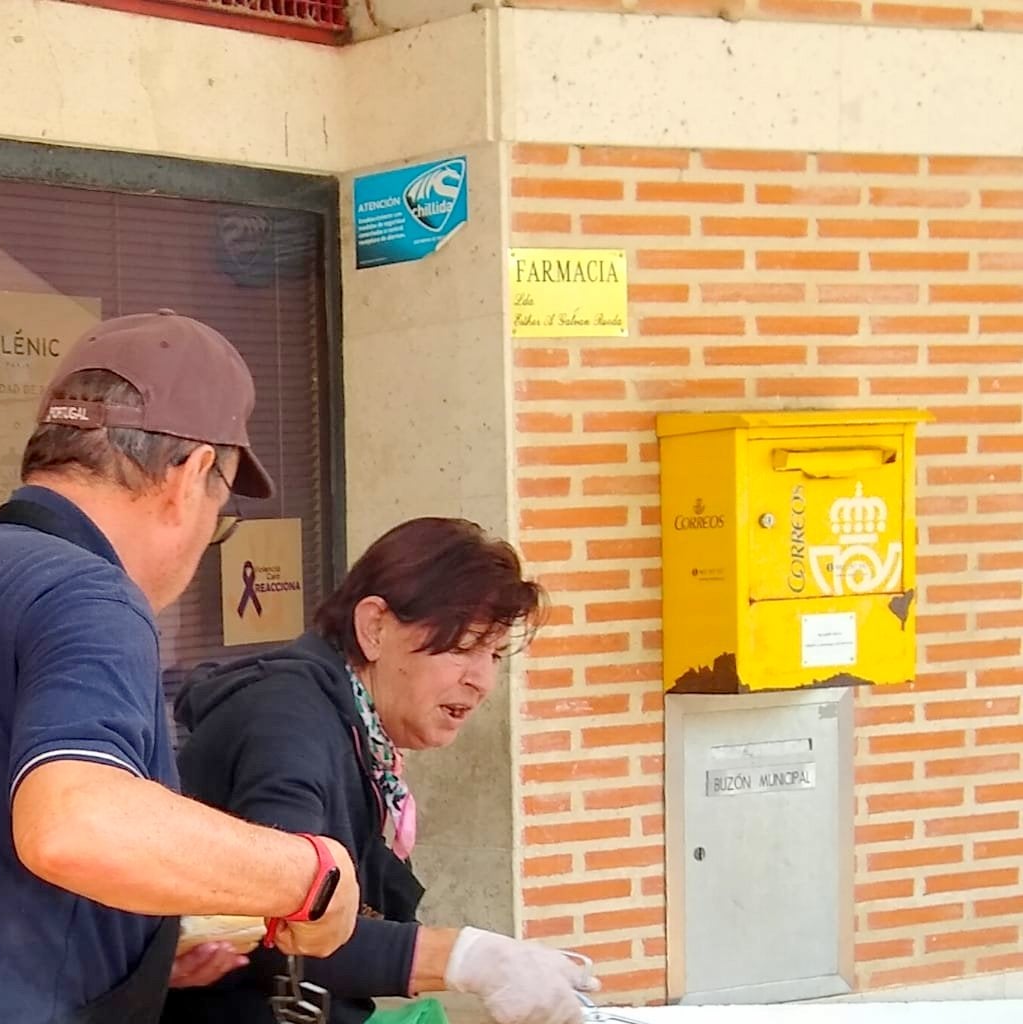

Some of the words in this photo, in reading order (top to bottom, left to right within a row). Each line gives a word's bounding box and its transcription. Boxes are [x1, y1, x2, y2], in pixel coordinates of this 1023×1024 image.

[358, 196, 400, 213] ATENCIÓN
[413, 200, 454, 217] chillida
[516, 260, 618, 282] FARMACIA
[47, 406, 89, 422] PORTUGAL
[674, 514, 724, 531] CORREOS
[788, 484, 806, 593] CORREOS
[255, 581, 300, 592] REACCIONA
[714, 773, 751, 792] BUZÓN
[759, 771, 811, 787] MUNICIPAL
